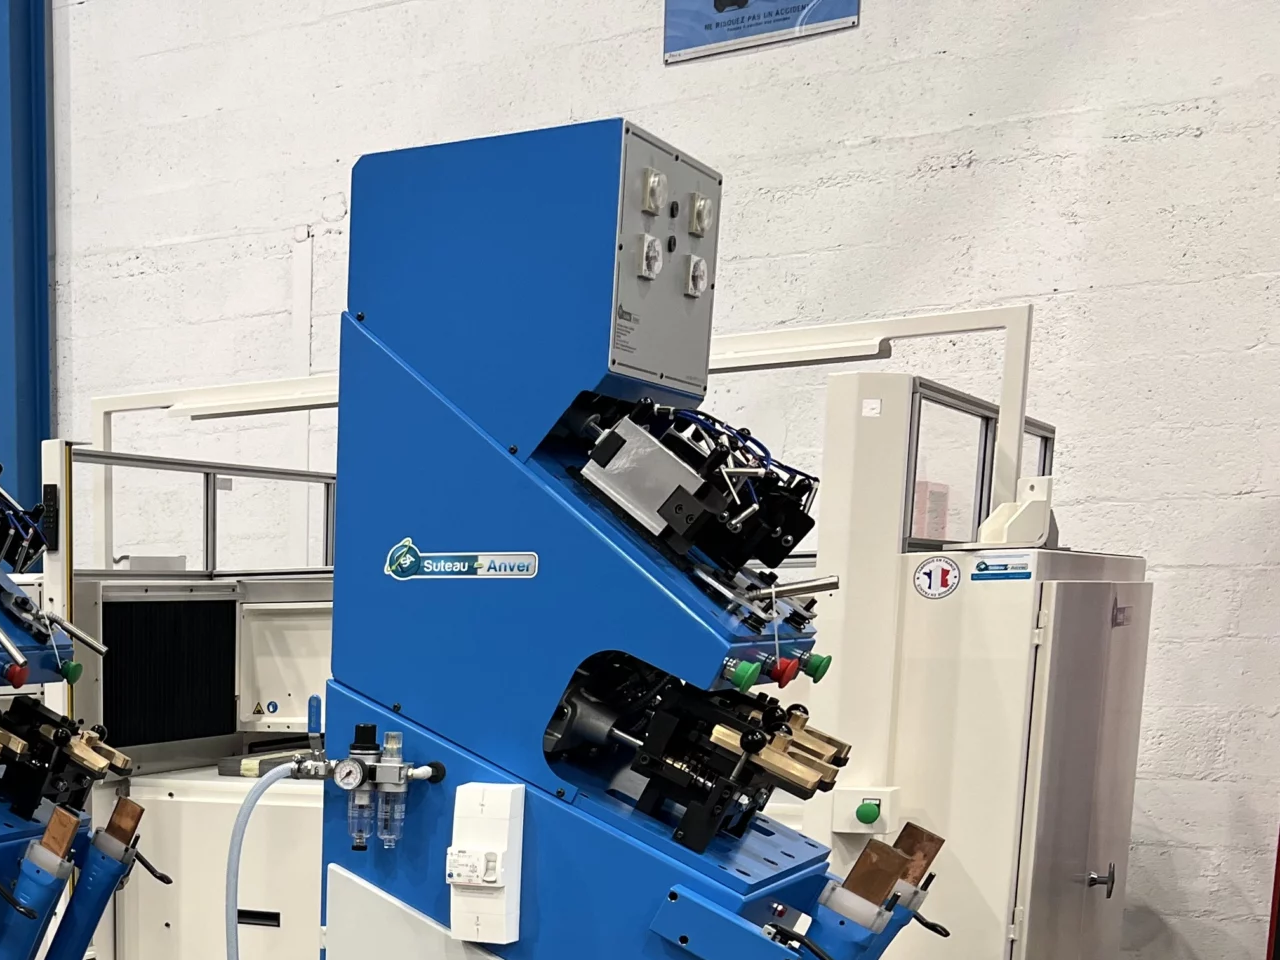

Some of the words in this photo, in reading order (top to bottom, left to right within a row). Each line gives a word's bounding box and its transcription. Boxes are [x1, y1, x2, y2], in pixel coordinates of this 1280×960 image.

[716, 16, 745, 28] RISQUEZ
[747, 14, 760, 22] PAS
[424, 560, 468, 572] Suteau
[487, 560, 531, 573] Anver
